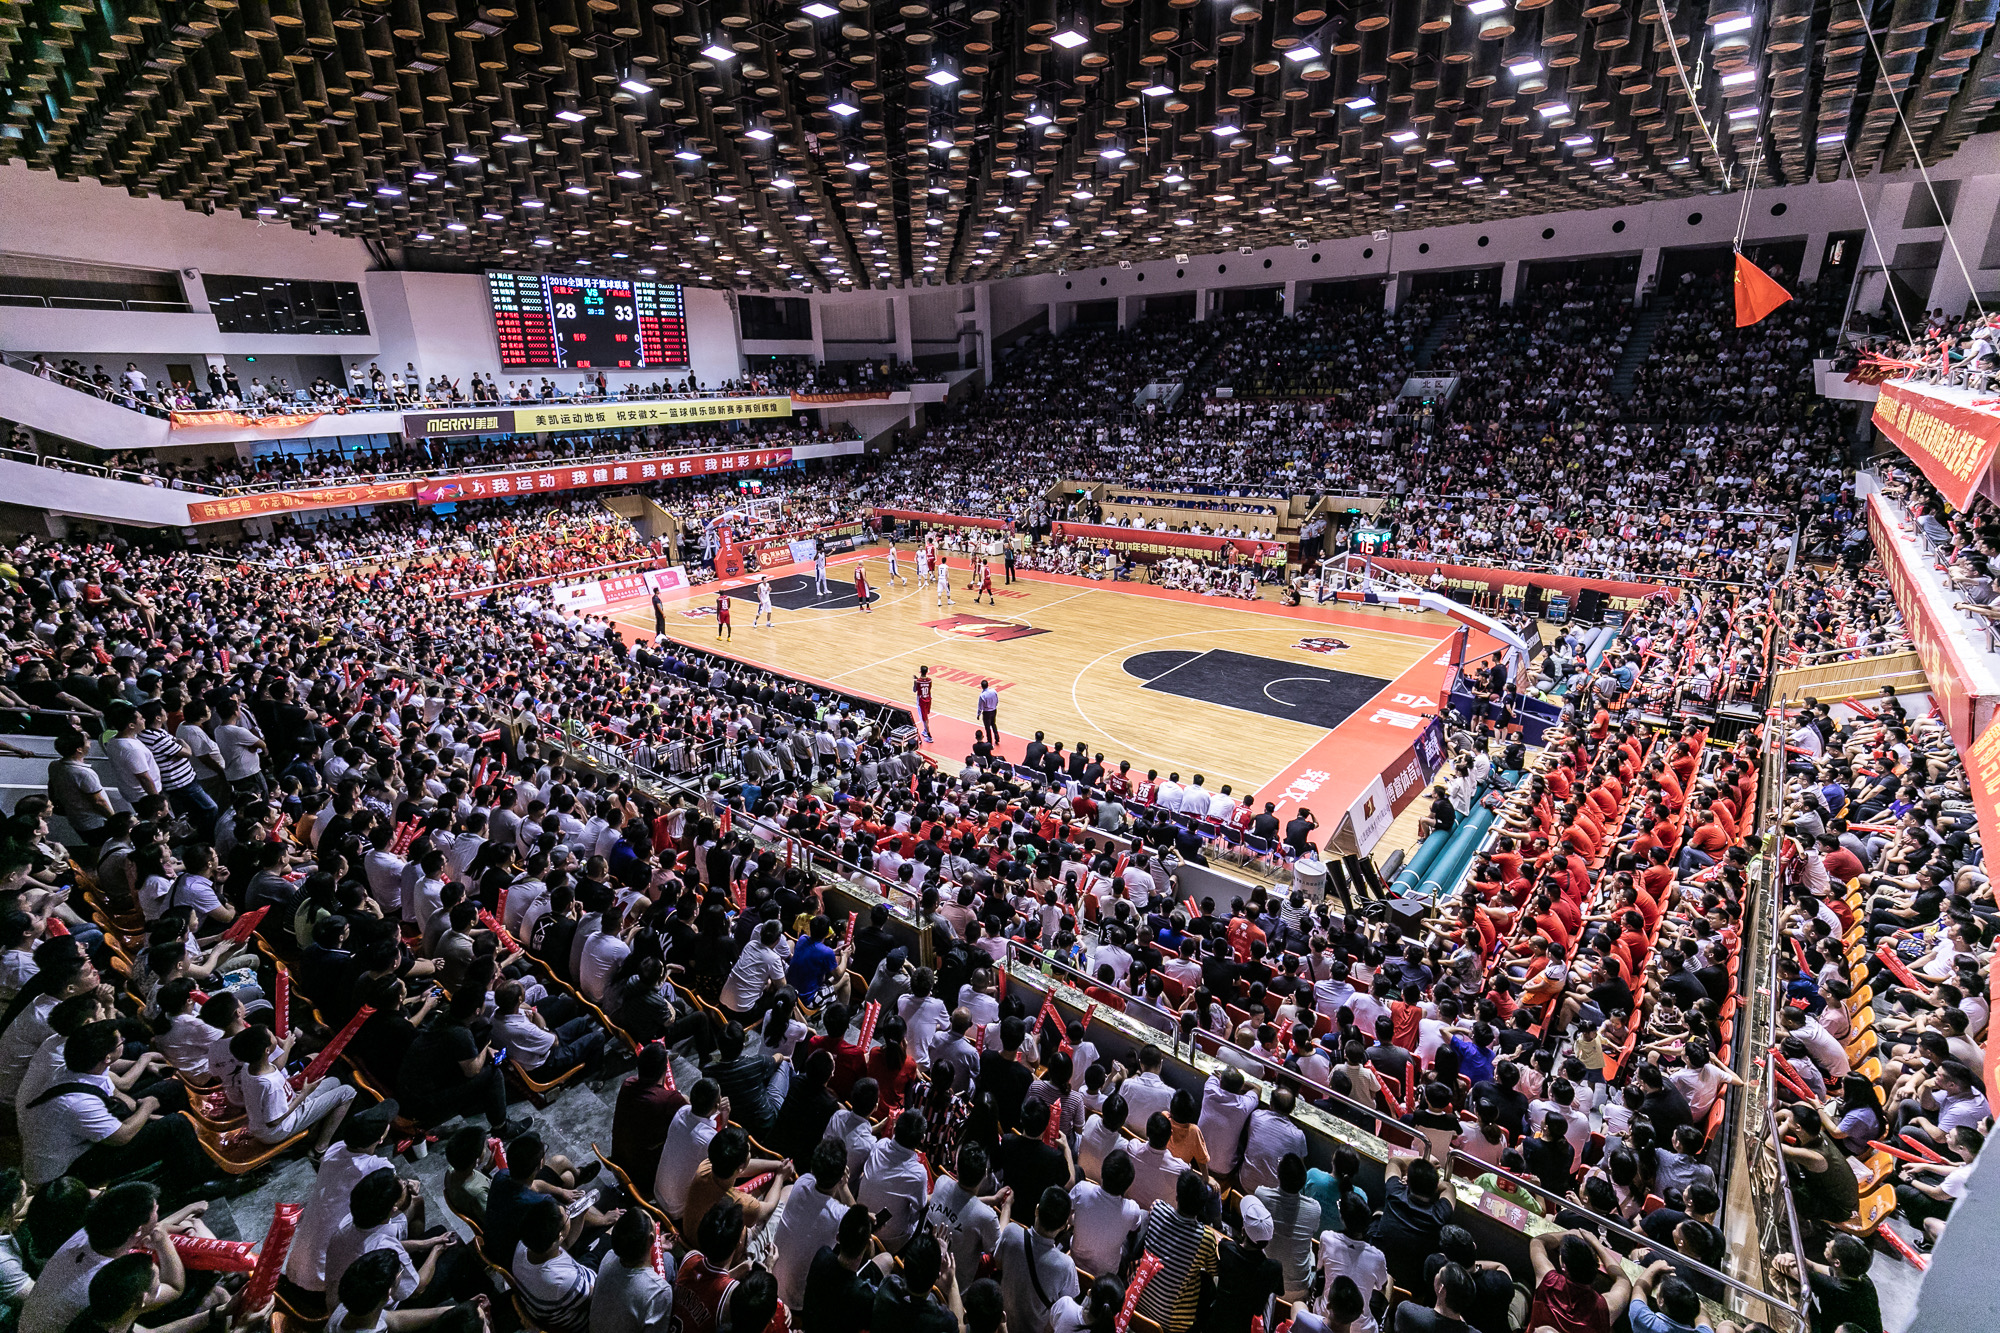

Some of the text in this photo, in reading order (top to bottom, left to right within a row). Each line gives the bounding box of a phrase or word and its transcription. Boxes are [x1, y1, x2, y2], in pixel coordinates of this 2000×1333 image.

[549, 277, 630, 290] 2019全国男子篮球联赛
[586, 288, 599, 297] VS
[555, 302, 577, 319] 28
[614, 305, 634, 321] 33
[557, 332, 563, 342] 1
[634, 333, 640, 343] 0
[561, 360, 567, 369] 1
[637, 359, 643, 368] 4
[1421, 380, 1444, 389] 北区
[535, 402, 778, 426] 美凯运动地板 祝安徽文一篮球俱乐部新赛季再创辉煌
[491, 455, 750, 494] 我运动 我健康 我快乐 我出彩
[203, 500, 253, 518] 卧薪尝胆
[258, 494, 305, 510] 不忘初心
[1360, 540, 1375, 555] 16
[921, 686, 929, 696] 10
[1138, 786, 1149, 798] 26
[1274, 768, 1331, 812] 安徽文一
